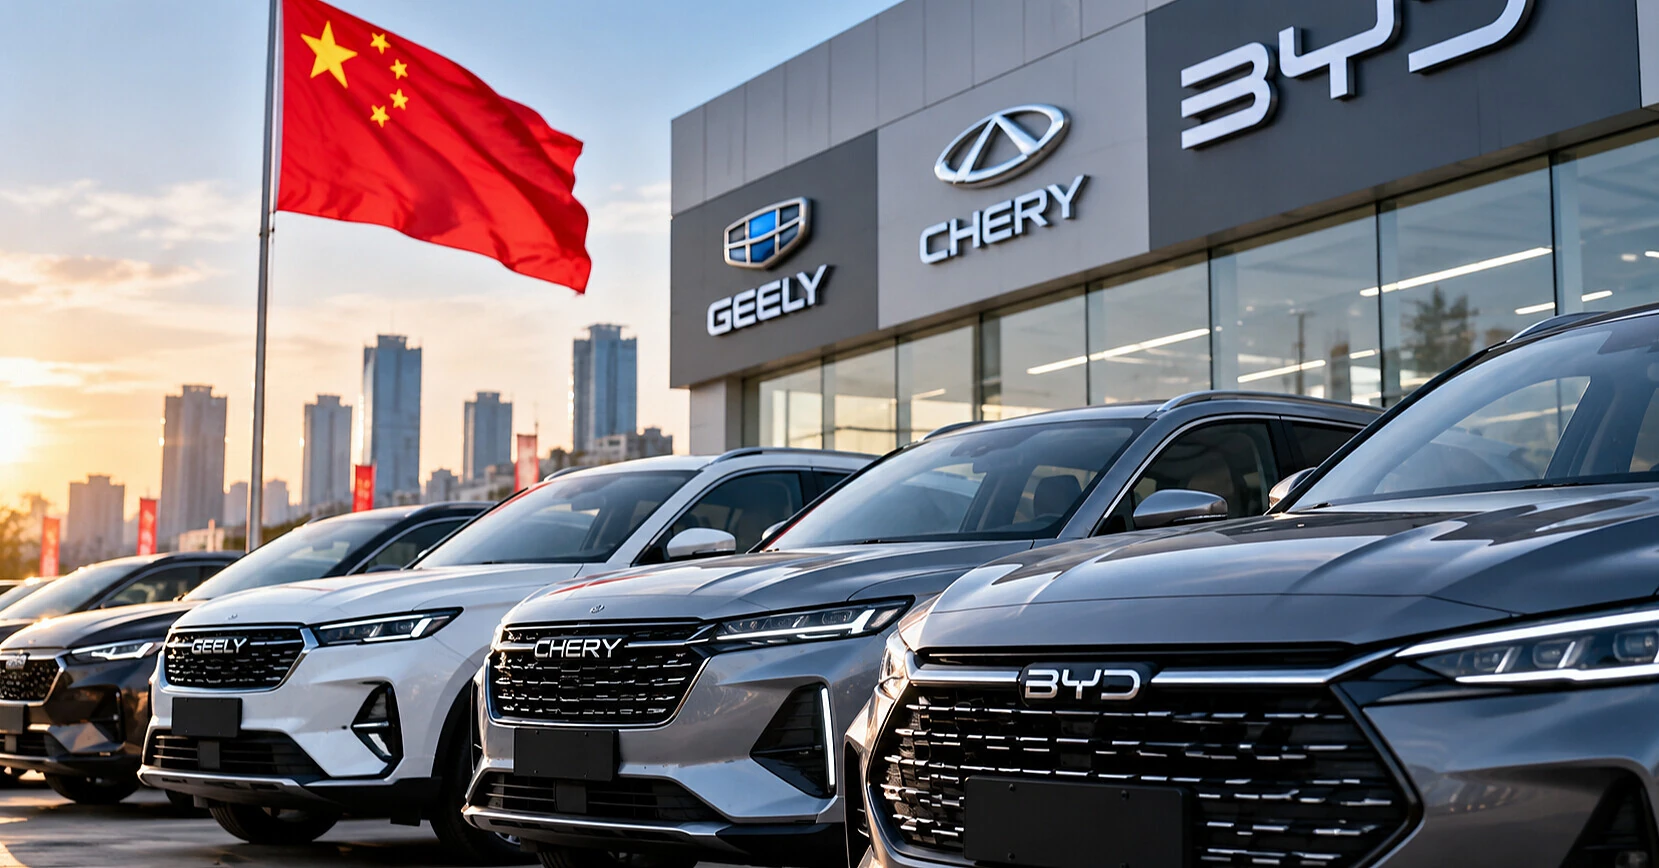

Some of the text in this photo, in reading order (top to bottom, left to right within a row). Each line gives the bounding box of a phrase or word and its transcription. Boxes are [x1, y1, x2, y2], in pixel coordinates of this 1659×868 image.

[918, 174, 1085, 265] CHERY
[706, 264, 827, 336] GEELY
[191, 638, 247, 654] GEELY
[534, 638, 622, 658] CHERY
[1025, 669, 1141, 700] BYD
